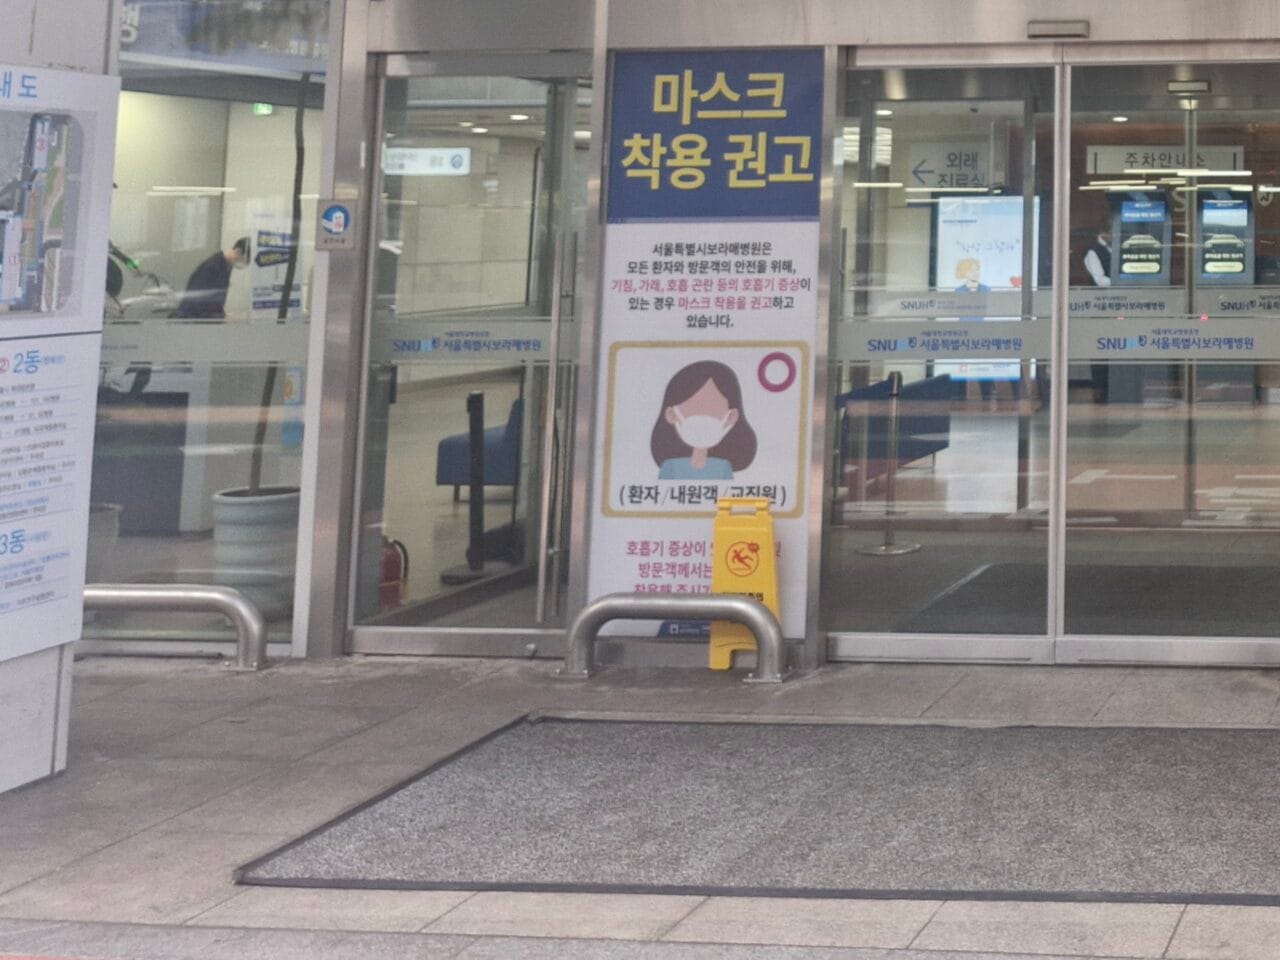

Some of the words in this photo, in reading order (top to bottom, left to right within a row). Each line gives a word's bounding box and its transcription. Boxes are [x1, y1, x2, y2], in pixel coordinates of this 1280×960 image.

[653, 69, 787, 125] 마스크
[622, 133, 711, 189] 착용
[724, 132, 814, 188] 권고
[946, 152, 979, 171] 외래
[652, 242, 772, 256] 서울특별시보라매병원은
[627, 262, 648, 275] 모든
[652, 261, 685, 275] 환자와
[688, 261, 731, 275] 방문객의
[735, 260, 767, 274] 안전을
[771, 260, 796, 274] 위해,
[611, 280, 637, 293] 기침,
[640, 279, 665, 292] 가래,
[667, 279, 689, 292] 호흡
[692, 279, 713, 292] 곤란
[717, 279, 738, 292] 등의
[742, 278, 775, 292] 호흡기
[778, 278, 811, 291] 증상이
[629, 297, 650, 311] 있는
[654, 297, 675, 311] 경우
[678, 297, 711, 310] 마스크
[714, 297, 746, 310] 착용을
[751, 296, 794, 310] 권고하고
[686, 315, 734, 329] 있습니다.
[920, 338, 1022, 352] 서울특별시보라매병원
[1151, 336, 1253, 351] 서울특별시보라매병원
[626, 541, 664, 557] 호흡기
[669, 541, 706, 557] 증상이
